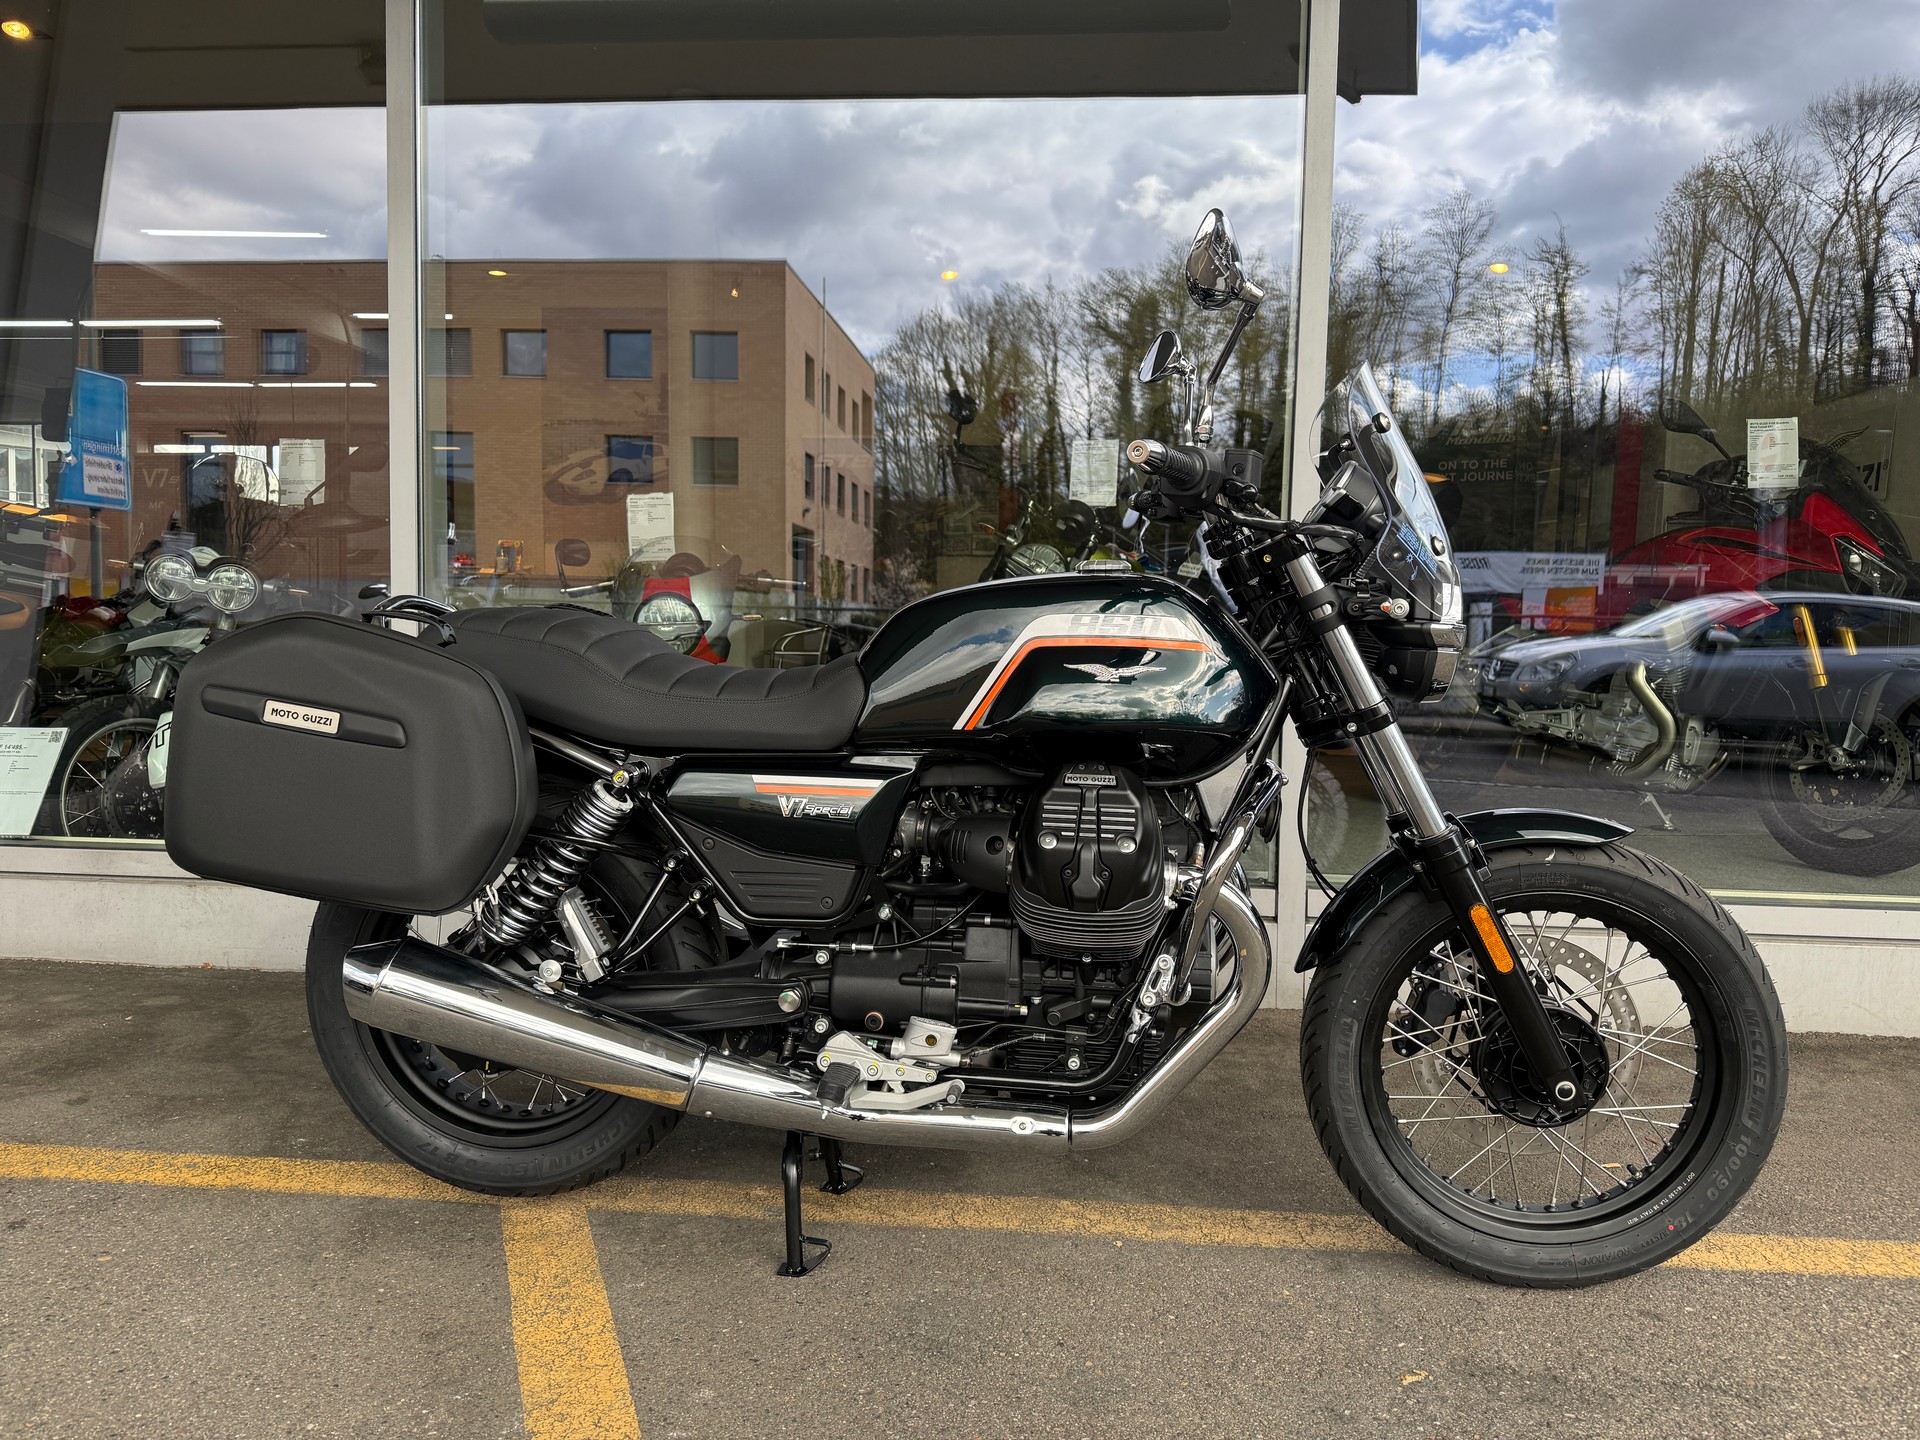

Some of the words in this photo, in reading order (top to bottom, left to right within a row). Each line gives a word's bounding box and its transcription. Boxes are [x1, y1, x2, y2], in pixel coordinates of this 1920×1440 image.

[1438, 461, 1457, 471] ON
[1462, 460, 1479, 470] TO
[1483, 459, 1508, 469] THE
[270, 707, 300, 722] MOTO
[301, 712, 334, 727] GUZZI
[777, 795, 809, 818] V7
[804, 803, 854, 817] Special
[1743, 1008, 1769, 1127] MICHELIN
